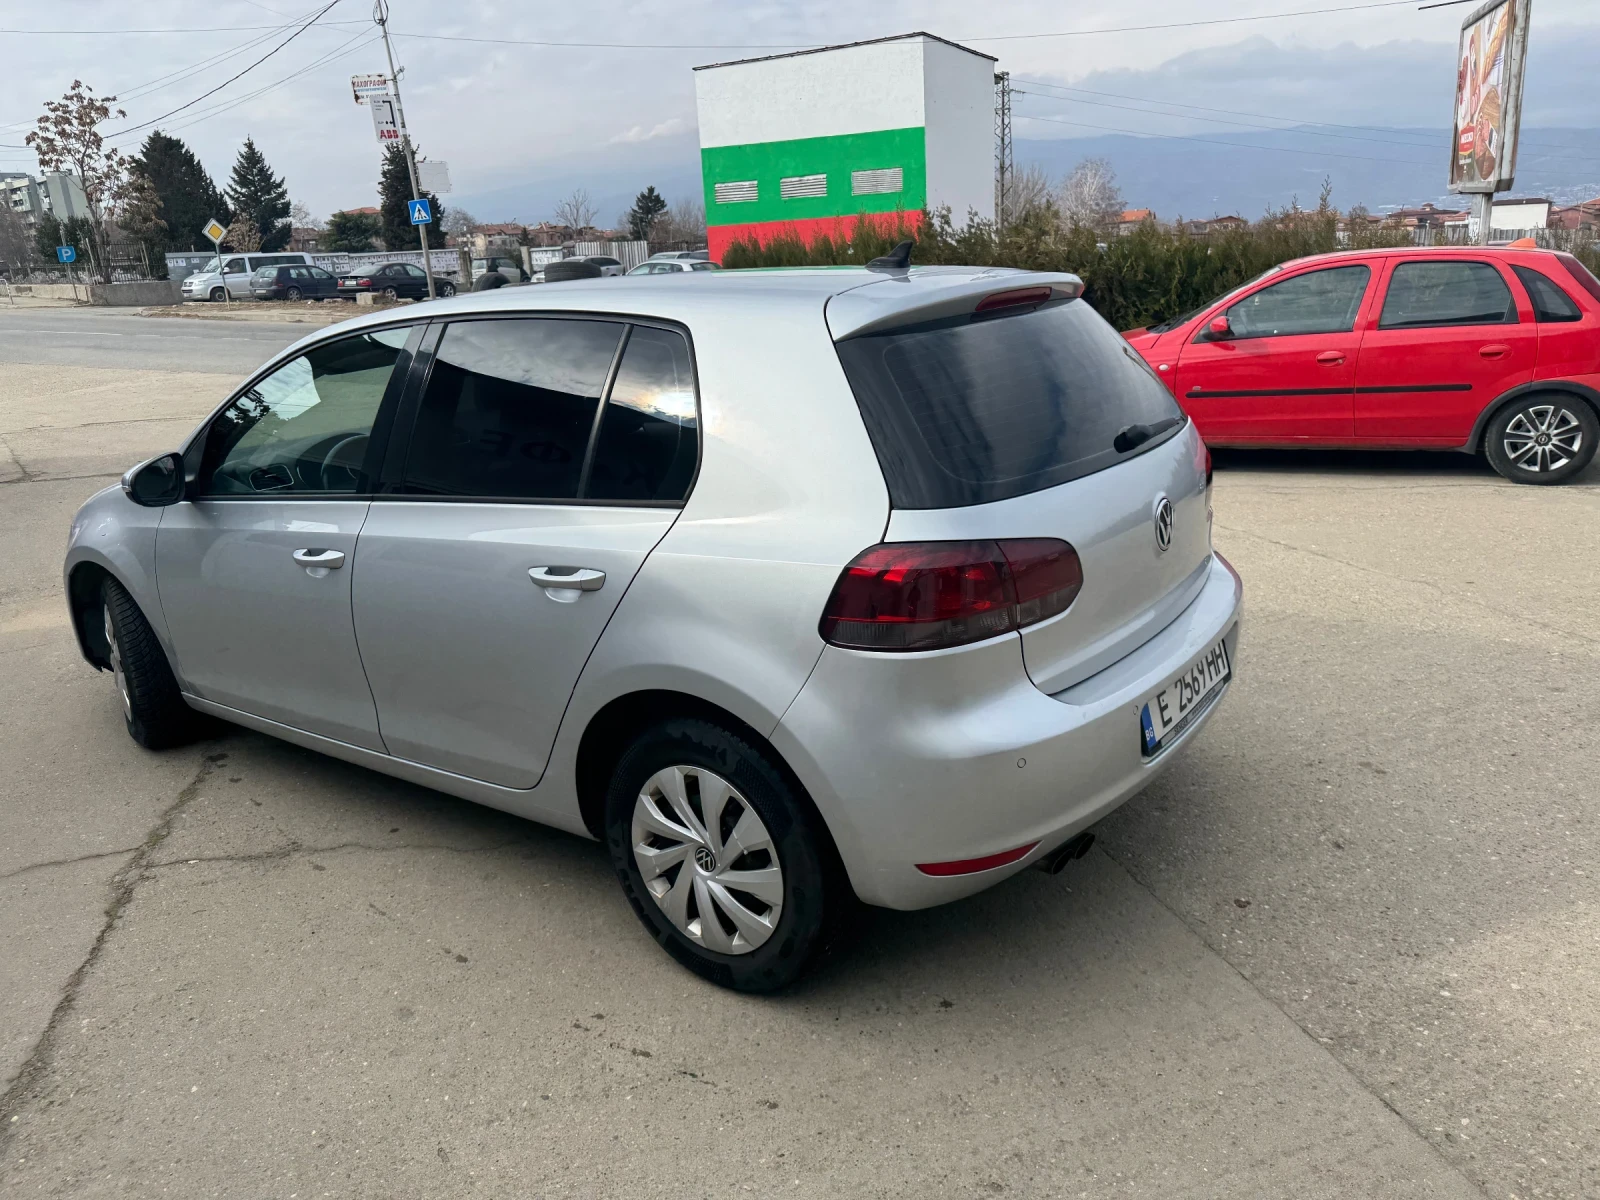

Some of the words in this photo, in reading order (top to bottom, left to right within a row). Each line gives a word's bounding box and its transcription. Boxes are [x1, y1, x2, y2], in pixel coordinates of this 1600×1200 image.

[380, 129, 399, 139] ABB
[62, 249, 71, 260] P
[1156, 690, 1172, 729] E
[1174, 660, 1206, 713] 2569
[1205, 642, 1226, 682] HH
[1145, 726, 1154, 741] BG
